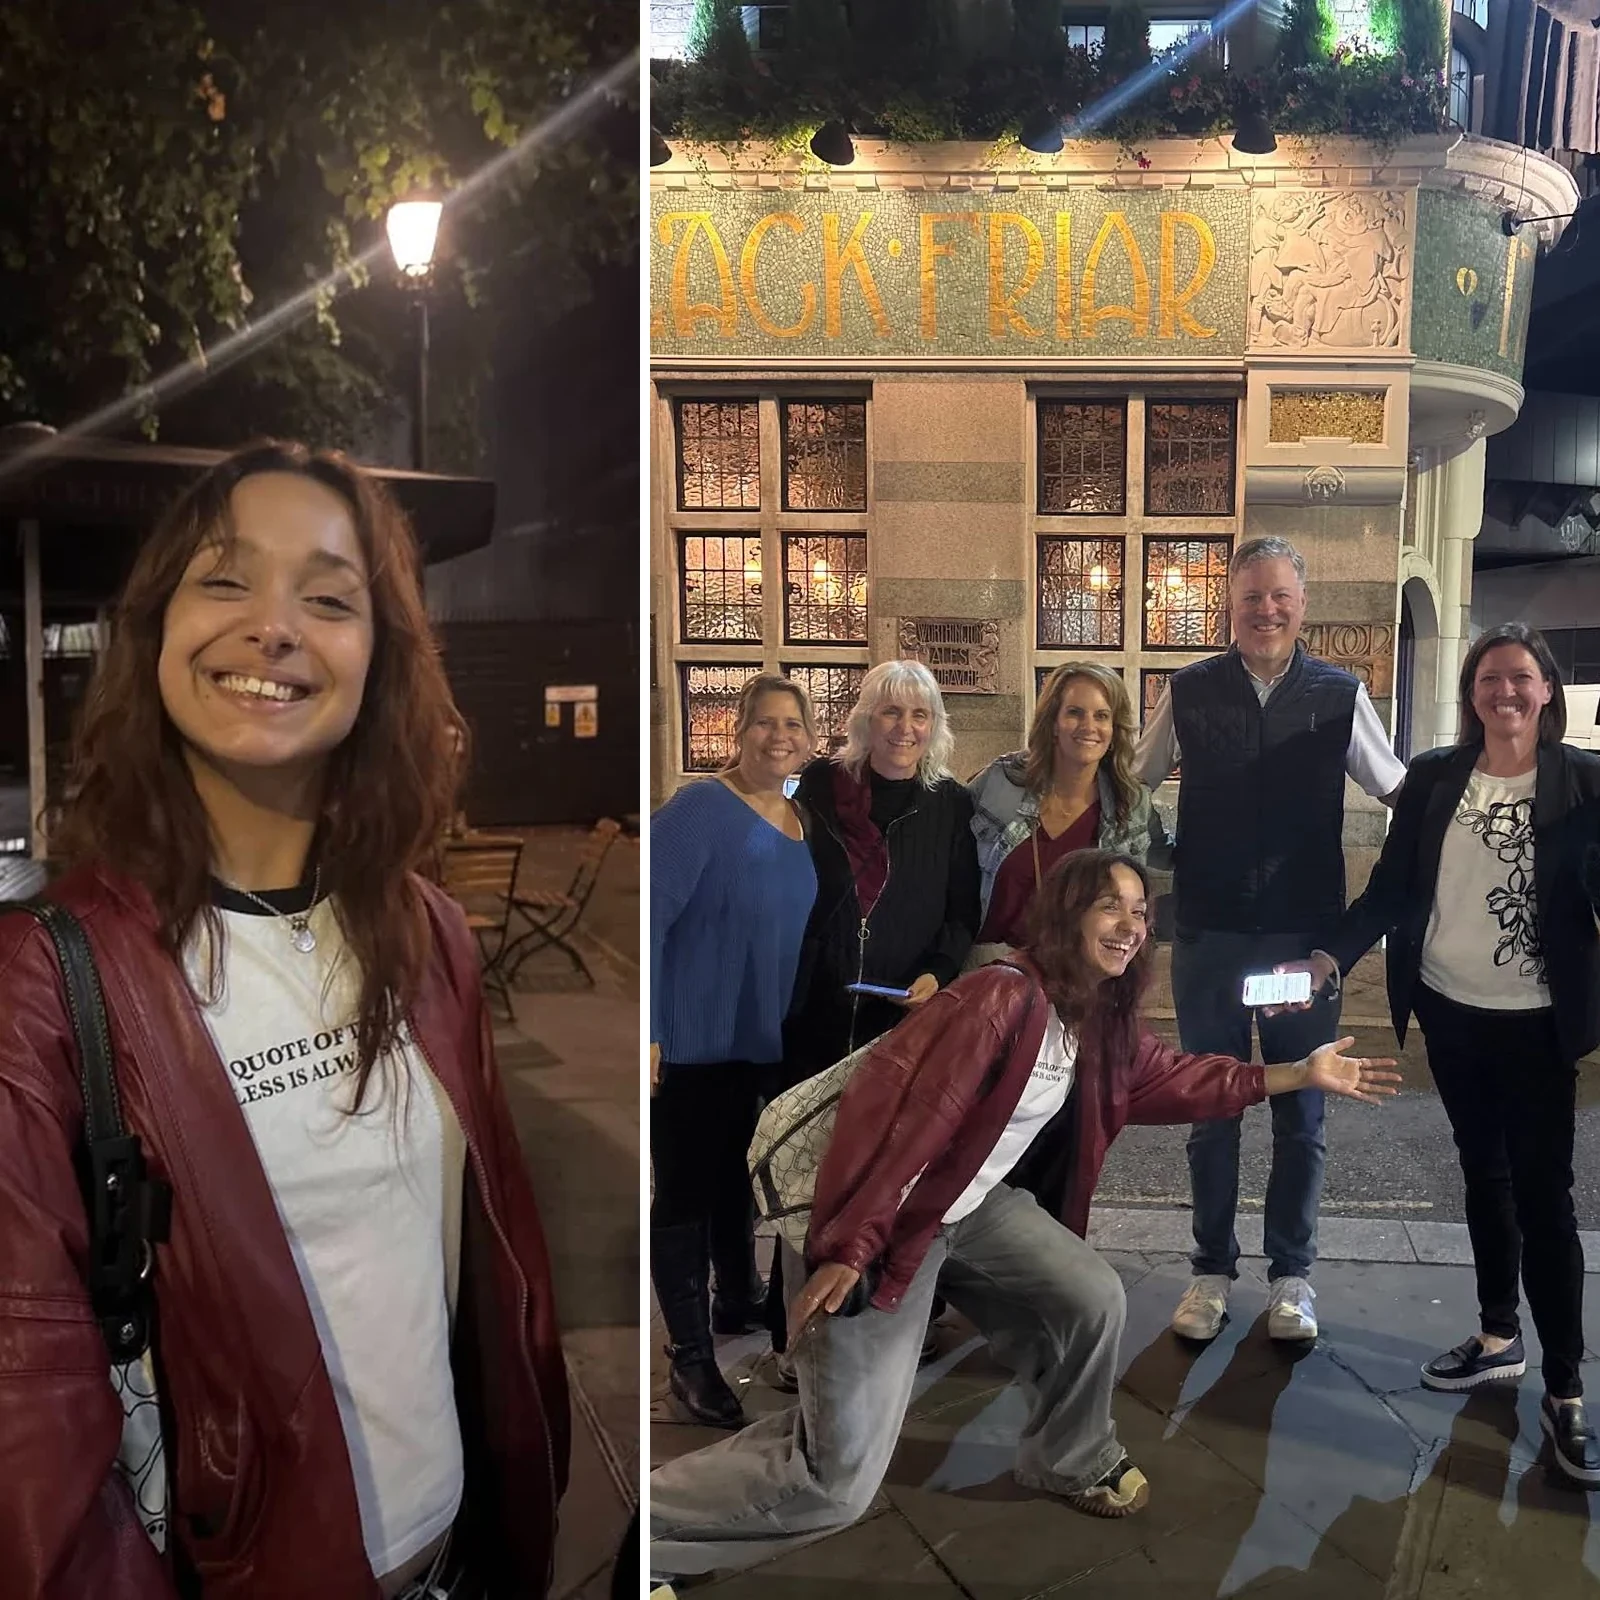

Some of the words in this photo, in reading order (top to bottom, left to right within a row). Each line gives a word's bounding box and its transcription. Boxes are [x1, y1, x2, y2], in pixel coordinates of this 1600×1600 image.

[650, 211, 894, 338] ACK
[920, 211, 1218, 339] FRIAR
[931, 647, 968, 665] ALES
[229, 1039, 311, 1080] QUOTE
[313, 1028, 344, 1051] OF
[287, 1067, 308, 1089] IS
[312, 1051, 357, 1083] ALW
